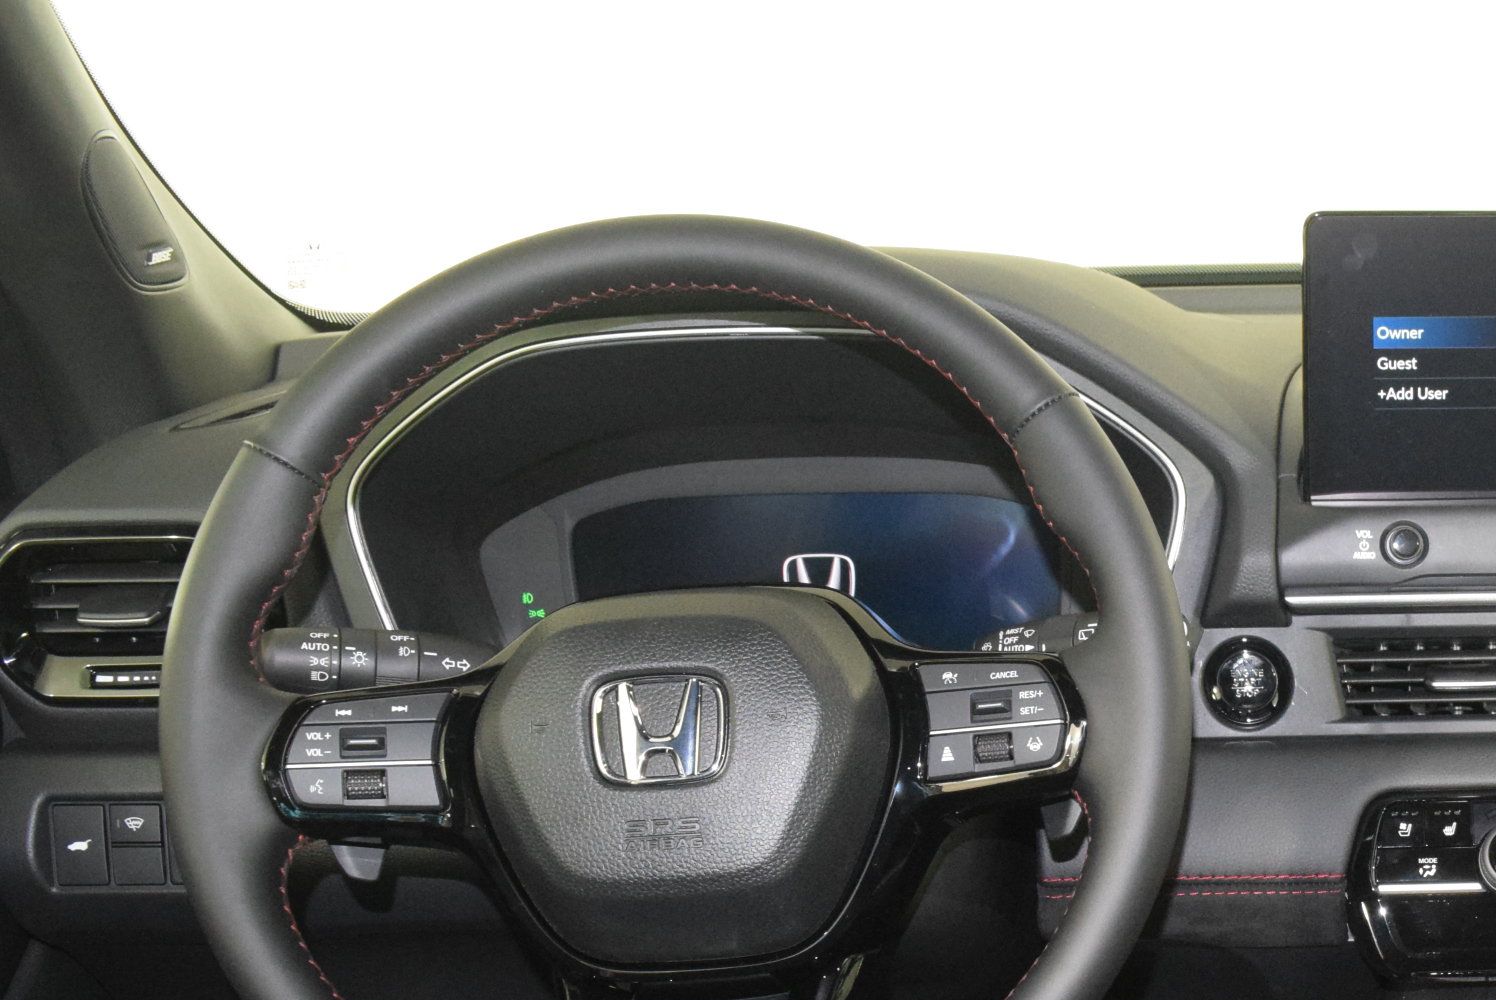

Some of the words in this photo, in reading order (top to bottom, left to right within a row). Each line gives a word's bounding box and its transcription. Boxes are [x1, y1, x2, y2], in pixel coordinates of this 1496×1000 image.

[1376, 326, 1425, 340] Owner
[1376, 356, 1418, 371] Guest
[1377, 386, 1414, 401] +Add
[1417, 386, 1449, 401] User
[1355, 529, 1373, 539] VOL
[1352, 551, 1376, 560] AUDIO
[1005, 627, 1024, 635] MIST
[390, 634, 410, 642] OFF
[1003, 636, 1019, 644] OFF
[300, 642, 330, 651] AUTO
[1003, 644, 1025, 652] AUTO
[989, 670, 1019, 680] CANCEL
[1235, 689, 1260, 698] STOP
[623, 817, 701, 835] SRS
